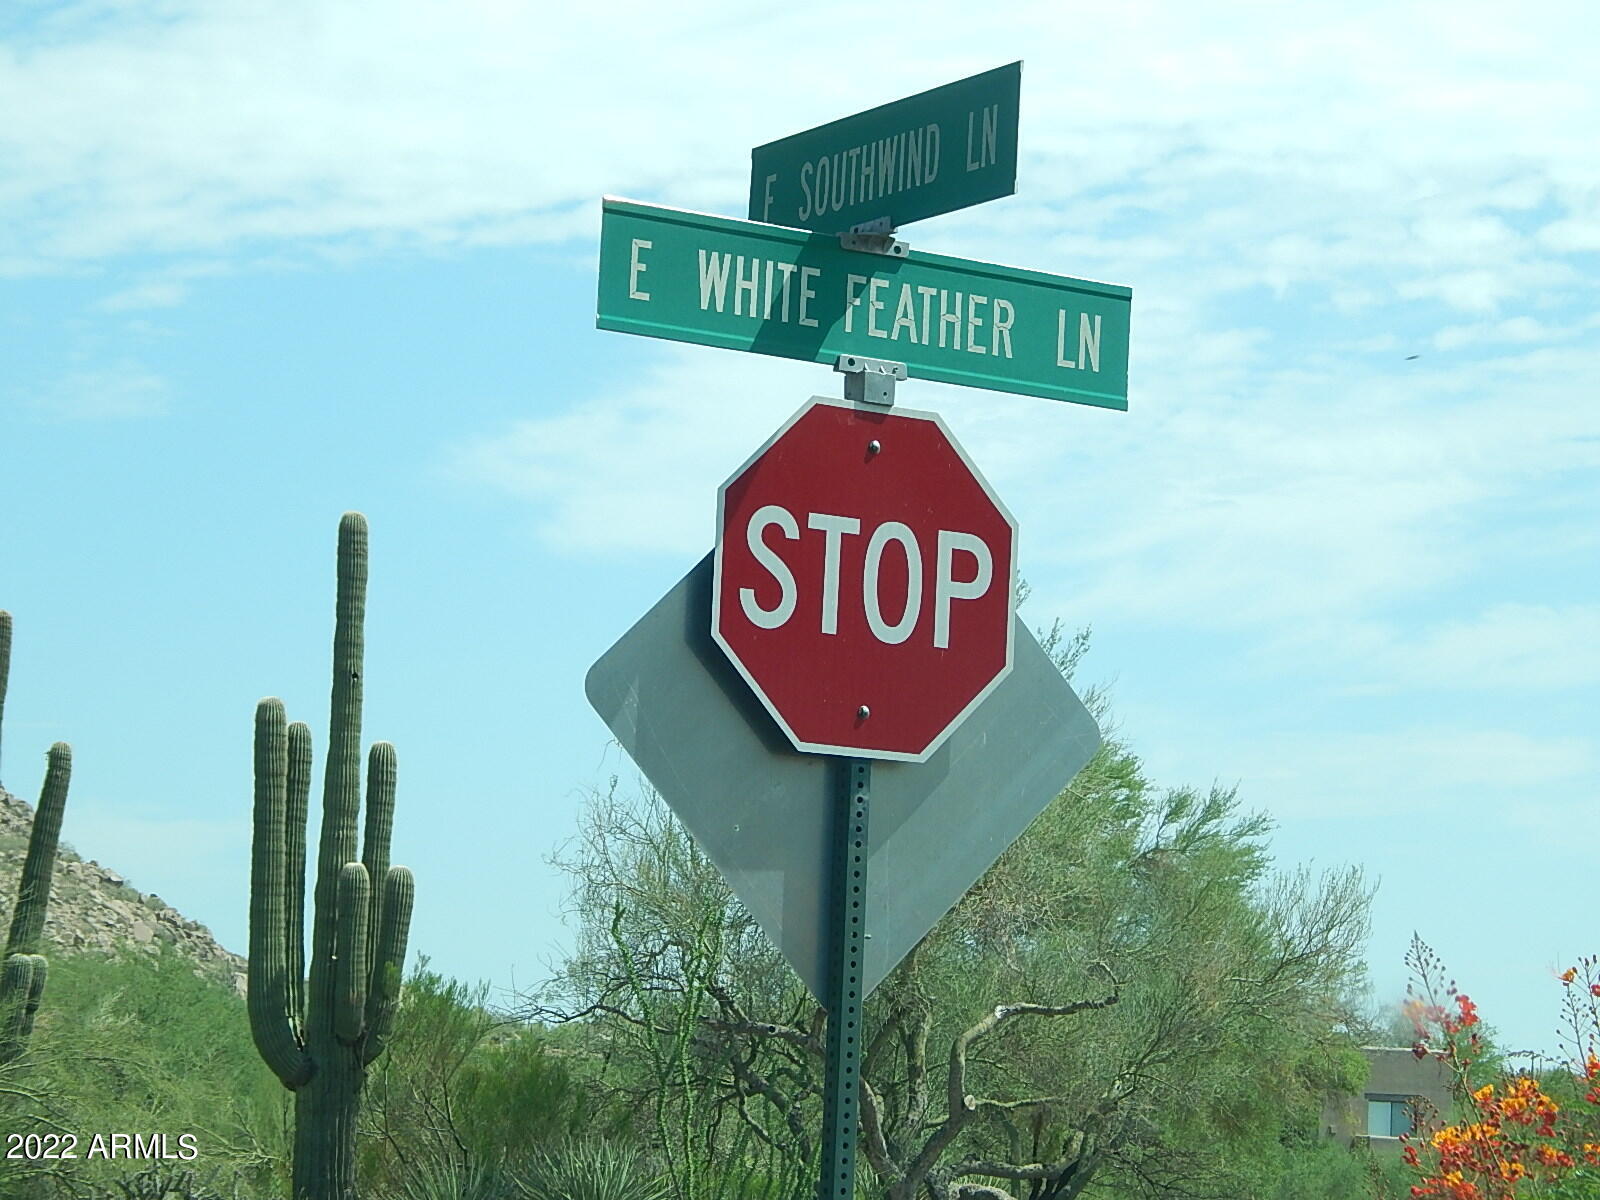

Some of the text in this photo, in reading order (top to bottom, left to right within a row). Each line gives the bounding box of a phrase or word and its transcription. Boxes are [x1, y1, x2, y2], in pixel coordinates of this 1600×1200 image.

[798, 123, 941, 222] SOUTHWIND
[966, 104, 999, 173] LN
[628, 238, 1102, 373] E WHITE FEATHER LN
[739, 505, 993, 649] STOP
